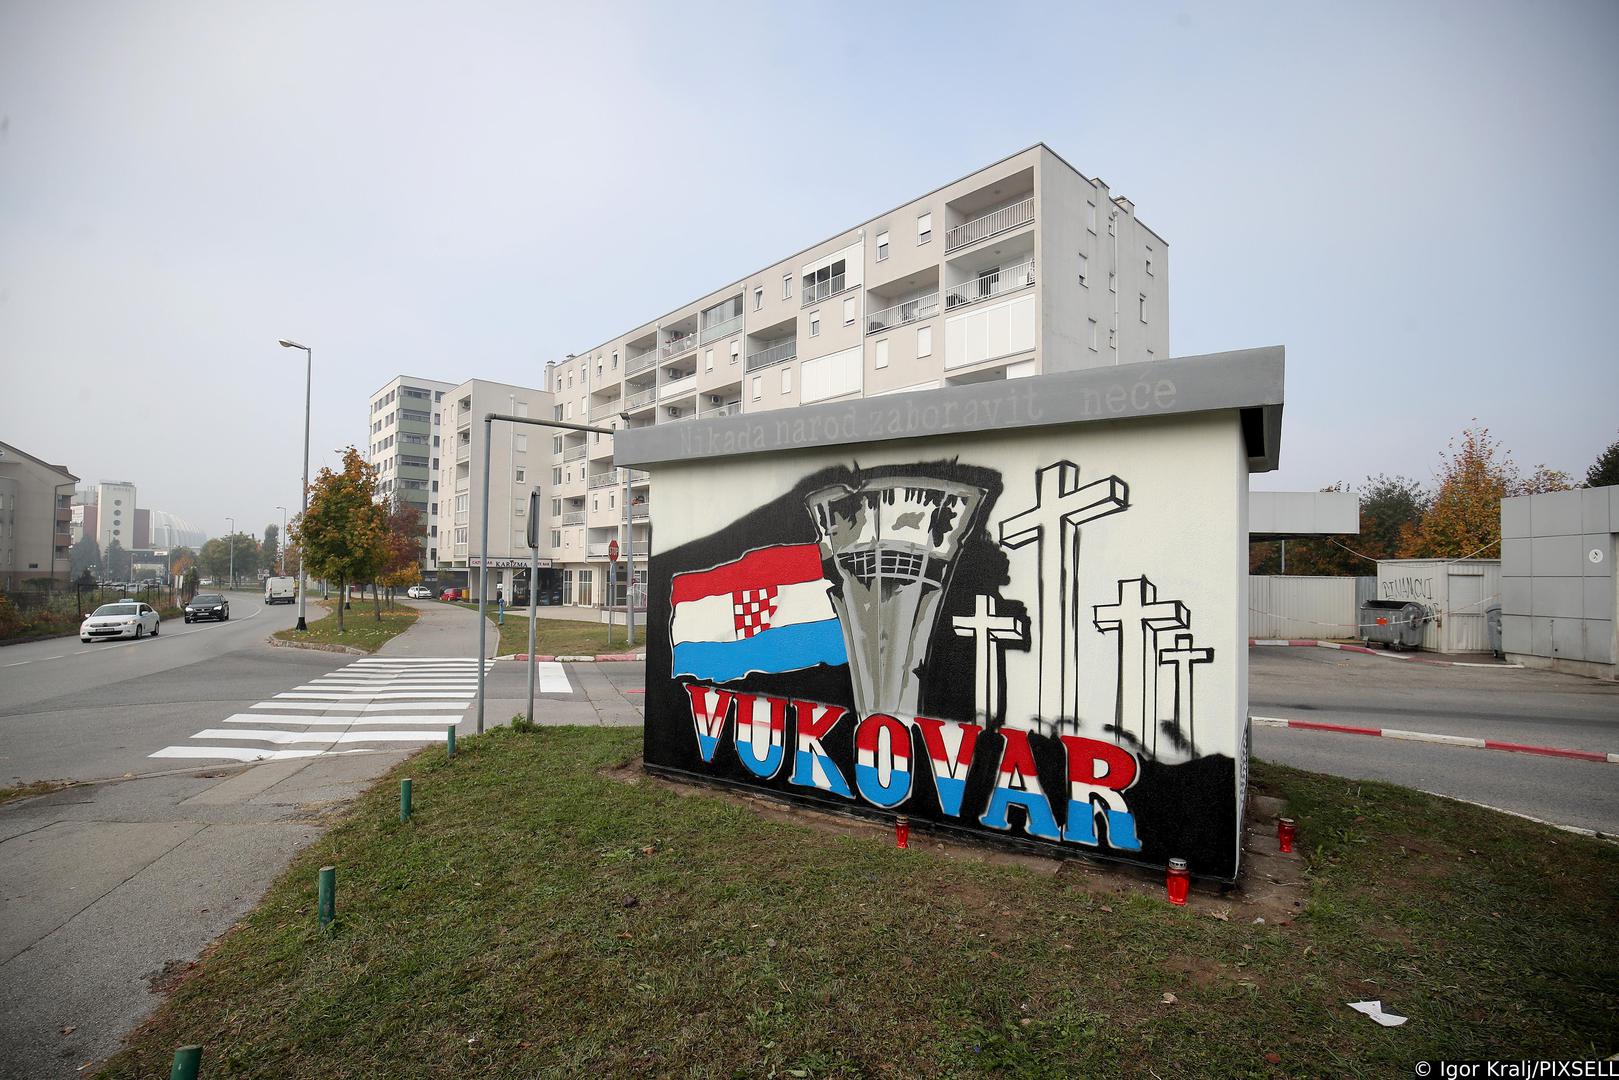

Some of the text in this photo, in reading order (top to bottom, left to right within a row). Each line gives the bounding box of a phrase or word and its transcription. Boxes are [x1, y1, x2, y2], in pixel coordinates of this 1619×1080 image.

[680, 370, 1177, 456] Nikada narod zaboravit neće
[495, 560, 528, 568] KARIZMA
[684, 682, 1143, 852] VUKOVAR
